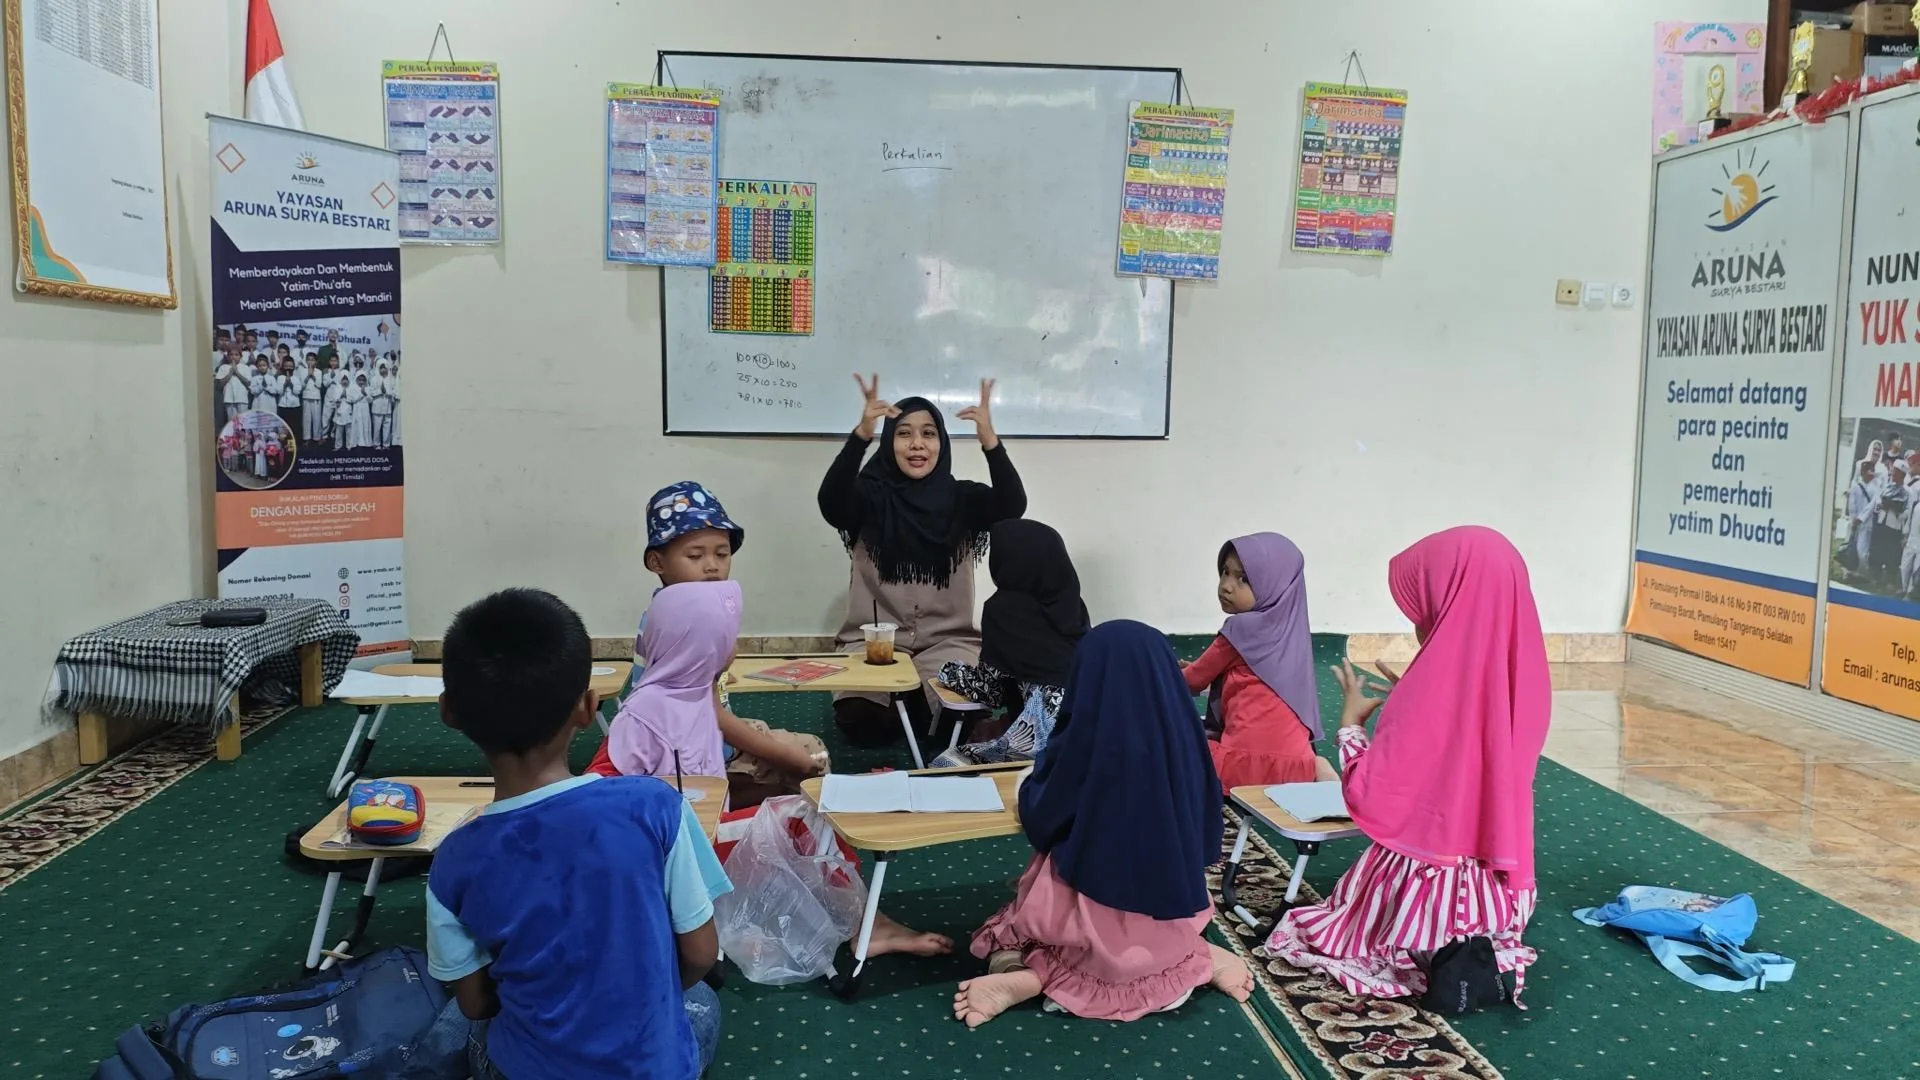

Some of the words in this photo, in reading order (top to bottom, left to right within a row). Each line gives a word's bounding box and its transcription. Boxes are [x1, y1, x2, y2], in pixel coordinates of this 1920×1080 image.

[398, 64, 432, 72] PERAGA
[434, 65, 481, 73] PENDIDIKAN
[623, 87, 655, 97] PERAGA
[1320, 86, 1347, 95] PERAGA
[1143, 106, 1172, 115] PERAGA
[1174, 109, 1219, 118] PENDIDIKAN
[882, 142, 943, 161] Perkalian
[291, 173, 325, 185] ARUNA
[276, 190, 343, 210] YAYASAN
[223, 200, 277, 218] ARUNA
[281, 206, 329, 224] SURYA
[332, 213, 391, 232] BESTARI
[229, 265, 315, 279] Memberdayakan
[317, 263, 337, 275] Dan
[339, 261, 394, 274] Membentuk
[1691, 249, 1787, 288] ARUNA
[280, 280, 352, 292] Yatim-Dhu'afa
[1710, 286, 1743, 299] SURYA
[1745, 281, 1787, 295] BESTARI
[240, 296, 281, 311] Menjadi
[283, 295, 328, 308] Generasi
[329, 294, 354, 306] Yang
[356, 292, 392, 304] Mandiri
[1656, 314, 1699, 358] YAYASAN
[1702, 311, 1738, 356] ARUNA
[1742, 308, 1776, 354] SURYA
[1779, 304, 1828, 353] BESTARI
[1860, 298, 1909, 346] YUK
[1667, 379, 1734, 405] Selamat
[1739, 378, 1807, 412] datang
[1677, 416, 1716, 441] para
[1721, 415, 1789, 443] pecinta
[1711, 445, 1745, 472] dan
[1683, 480, 1773, 509] pemerhati
[250, 505, 301, 518] DENGAN
[303, 502, 376, 515] BERSEDEKAH
[1668, 511, 1714, 535] yatim
[1718, 512, 1786, 547] Dhuafa
[253, 574, 286, 582] Rekening
[287, 572, 311, 580] Donasi
[1704, 590, 1718, 604] Blok
[1720, 594, 1725, 606] A
[1736, 599, 1745, 611] No
[1747, 601, 1751, 612] 9
[1752, 601, 1762, 614] RT
[1763, 604, 1776, 618] 003
[1777, 607, 1791, 622] RW
[1791, 612, 1806, 625] 010
[1697, 610, 1728, 631] Pamulang
[1729, 618, 1765, 641] Tangerang
[1766, 627, 1793, 645] Selatan
[1693, 629, 1716, 646] Banten
[1716, 636, 1737, 652] 15417
[1891, 642, 1918, 664] Telp.
[1843, 658, 1873, 679] Email
